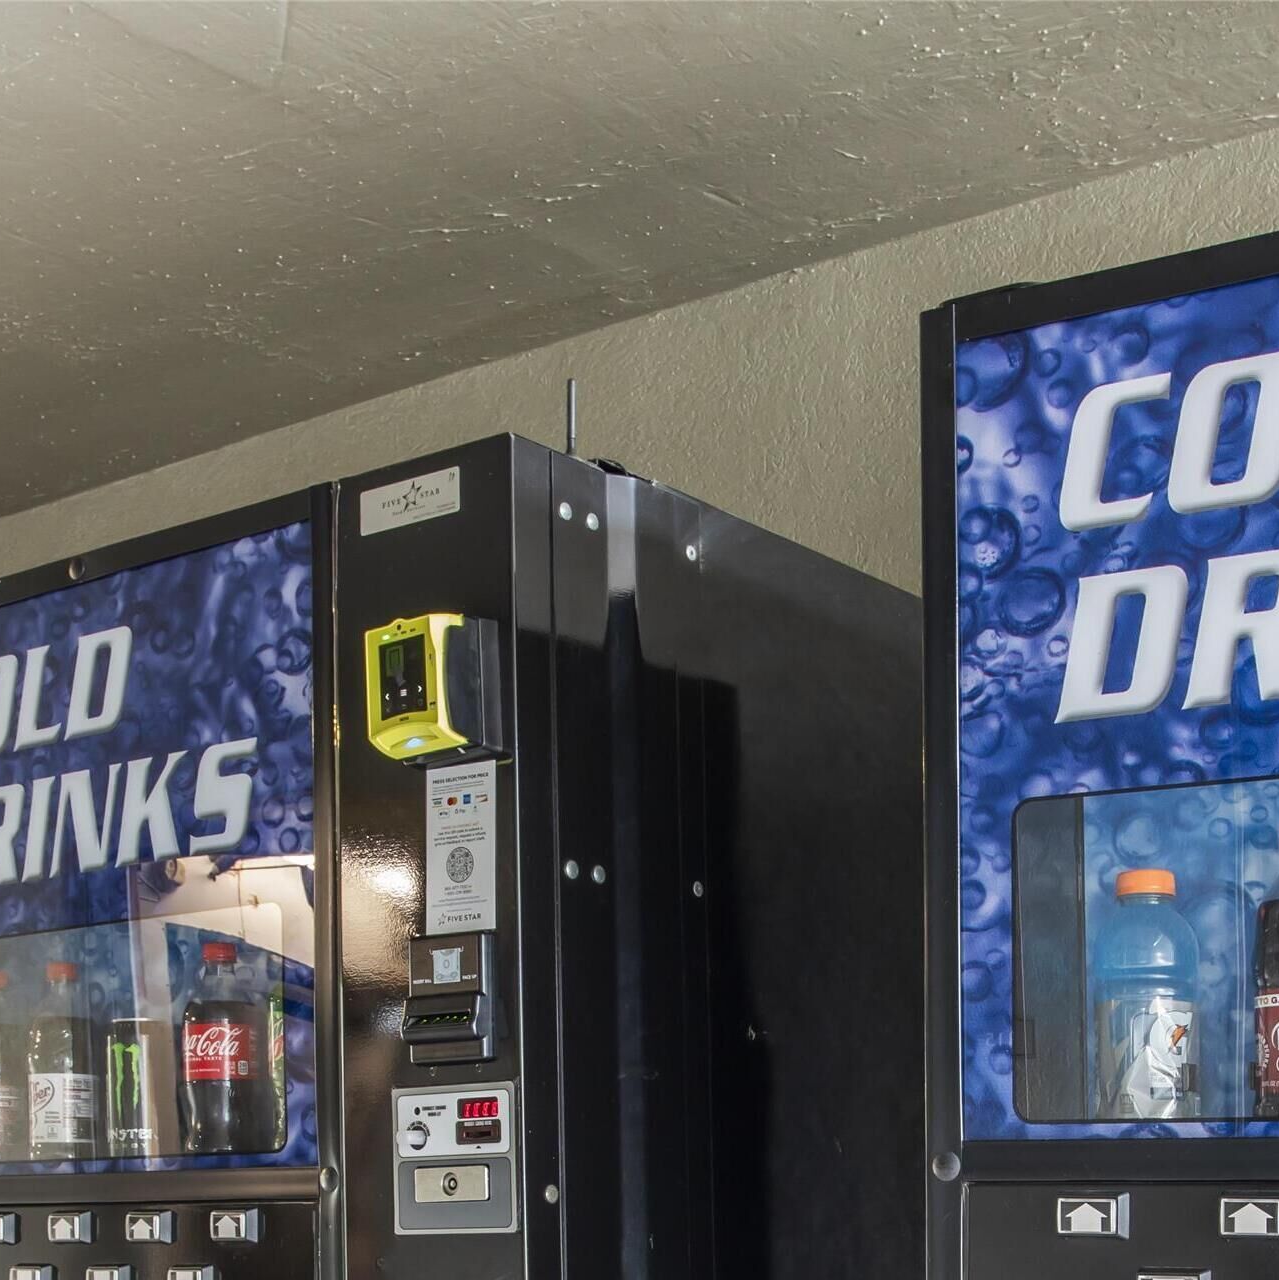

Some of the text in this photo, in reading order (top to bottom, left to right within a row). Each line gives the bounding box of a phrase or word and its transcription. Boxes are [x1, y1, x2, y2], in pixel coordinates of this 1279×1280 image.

[381, 488, 440, 510] FIVE STAR
[447, 912, 482, 923] FIVE STAR
